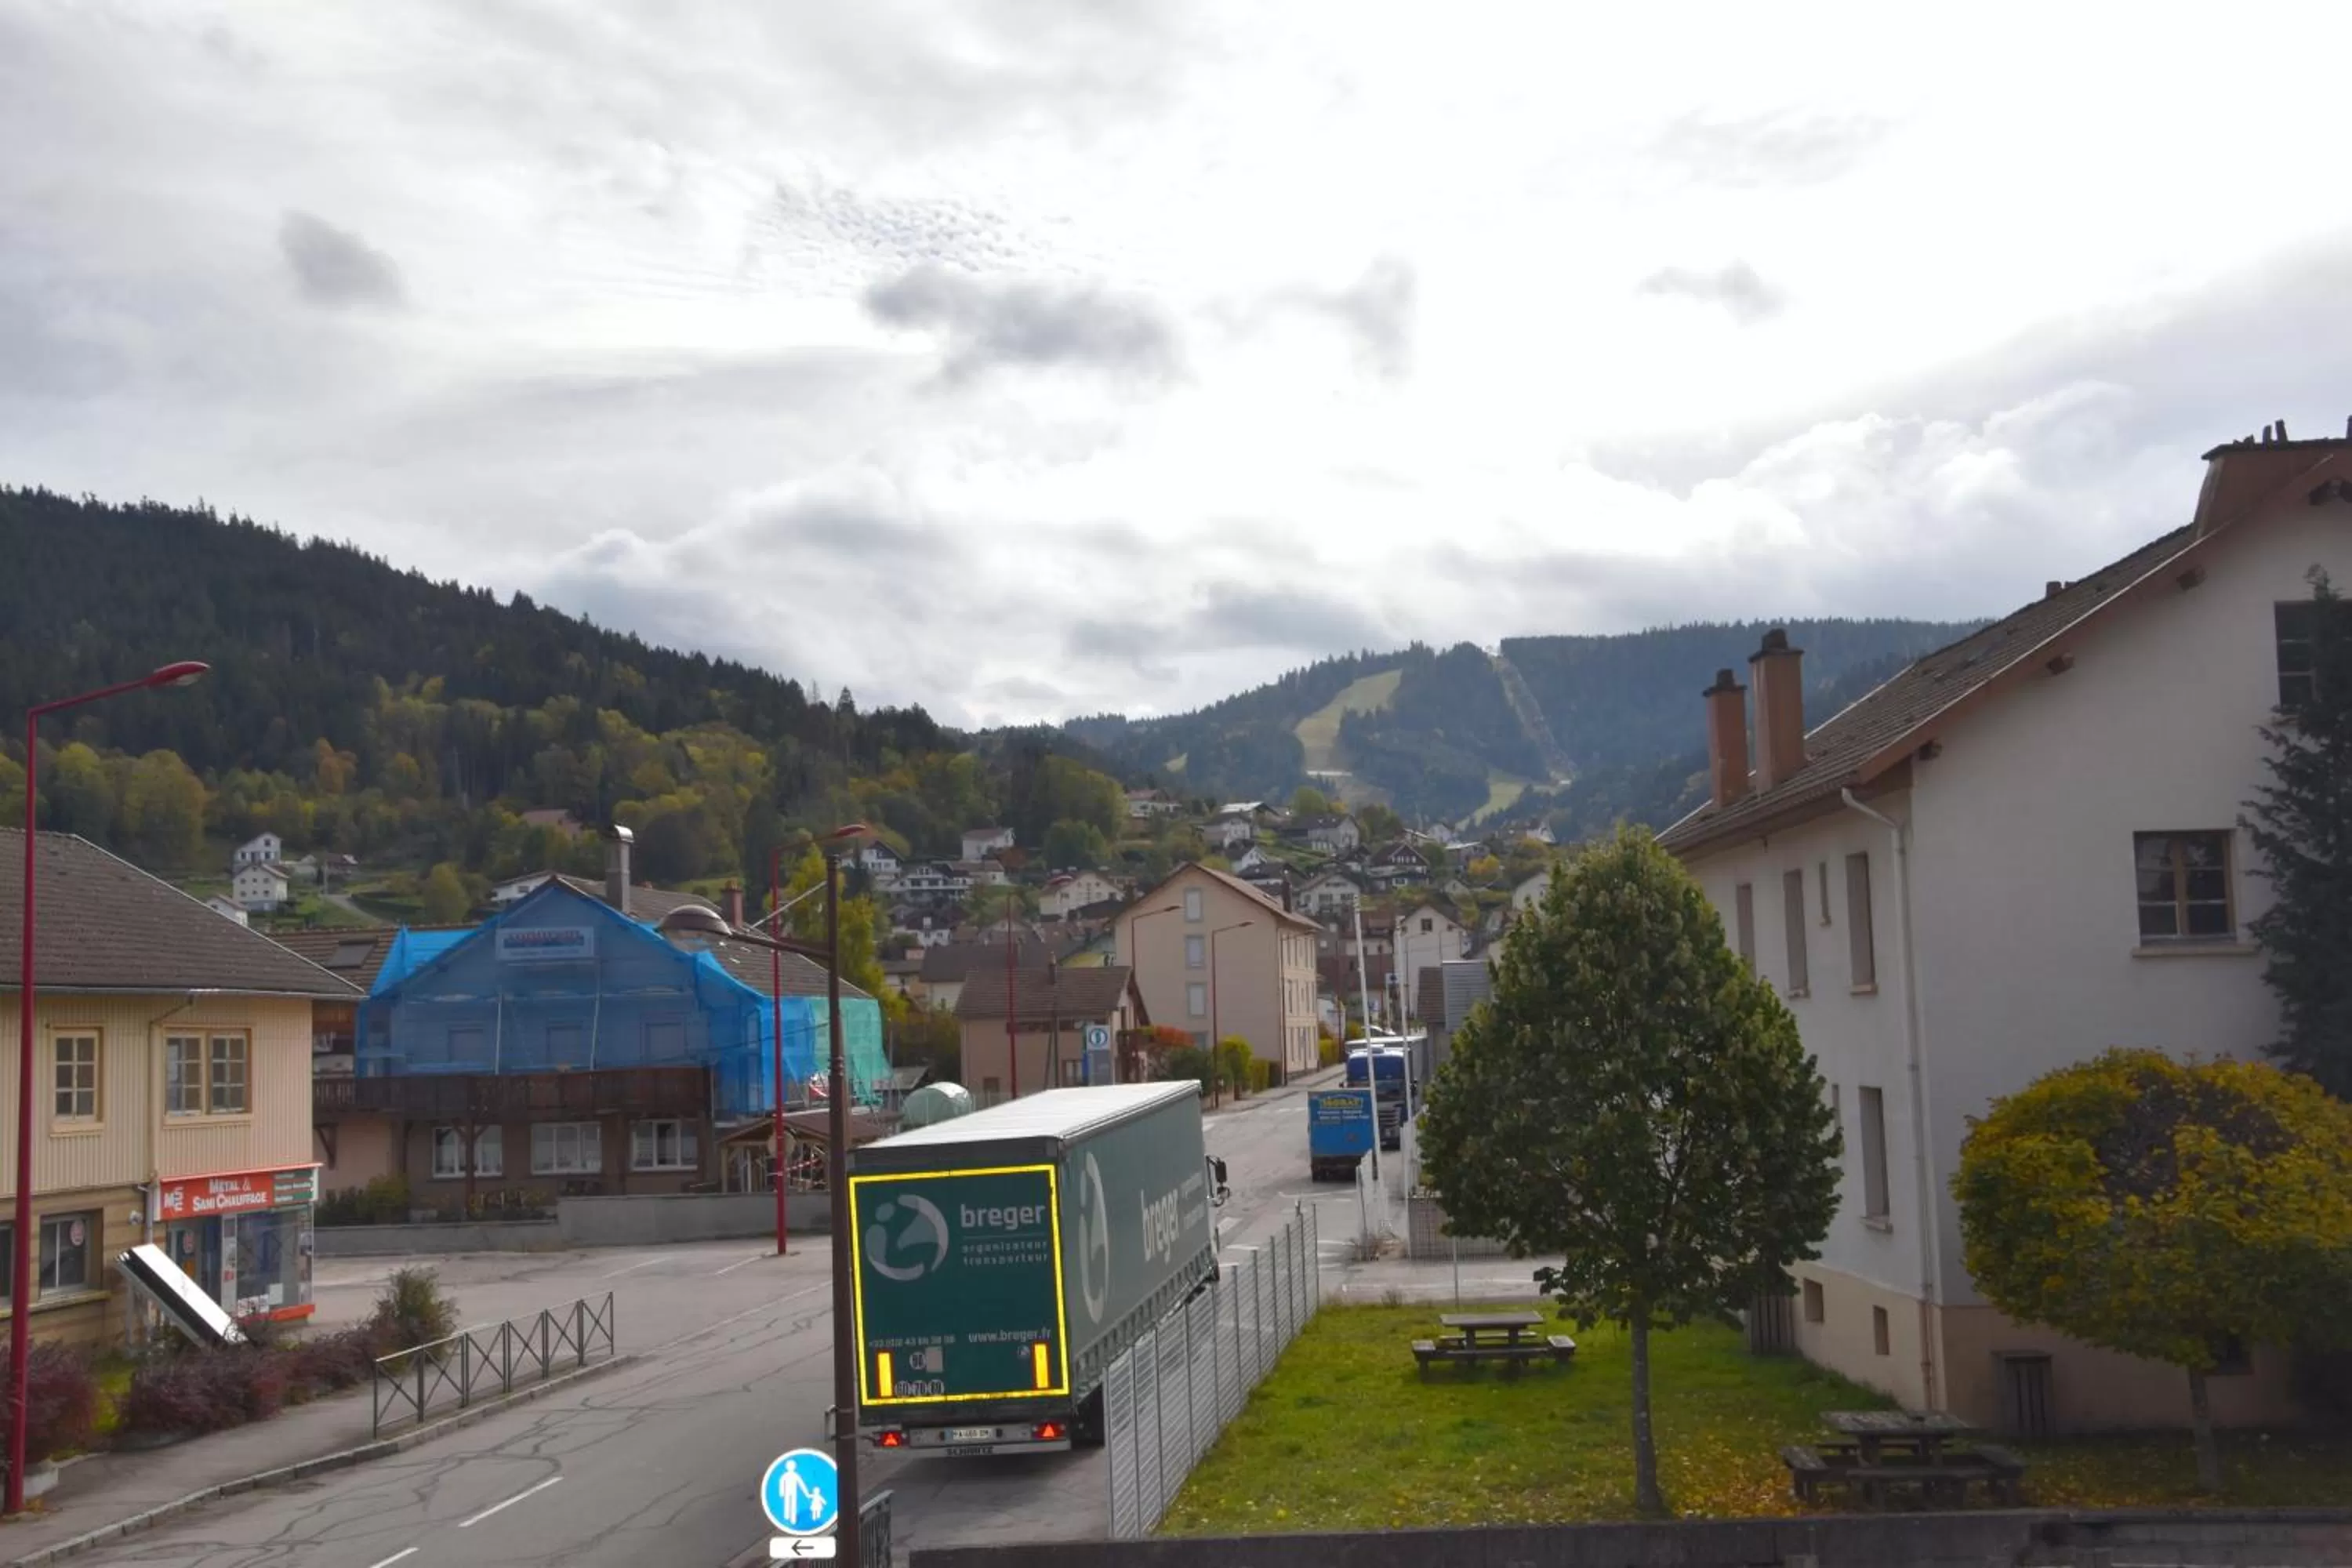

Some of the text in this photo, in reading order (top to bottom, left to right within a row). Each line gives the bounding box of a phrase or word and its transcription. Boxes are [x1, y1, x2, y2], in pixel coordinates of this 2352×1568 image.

[960, 1203, 1046, 1230] breger
[1141, 1188, 1179, 1265] breger
[968, 1327, 1051, 1343] www.breger.fr
